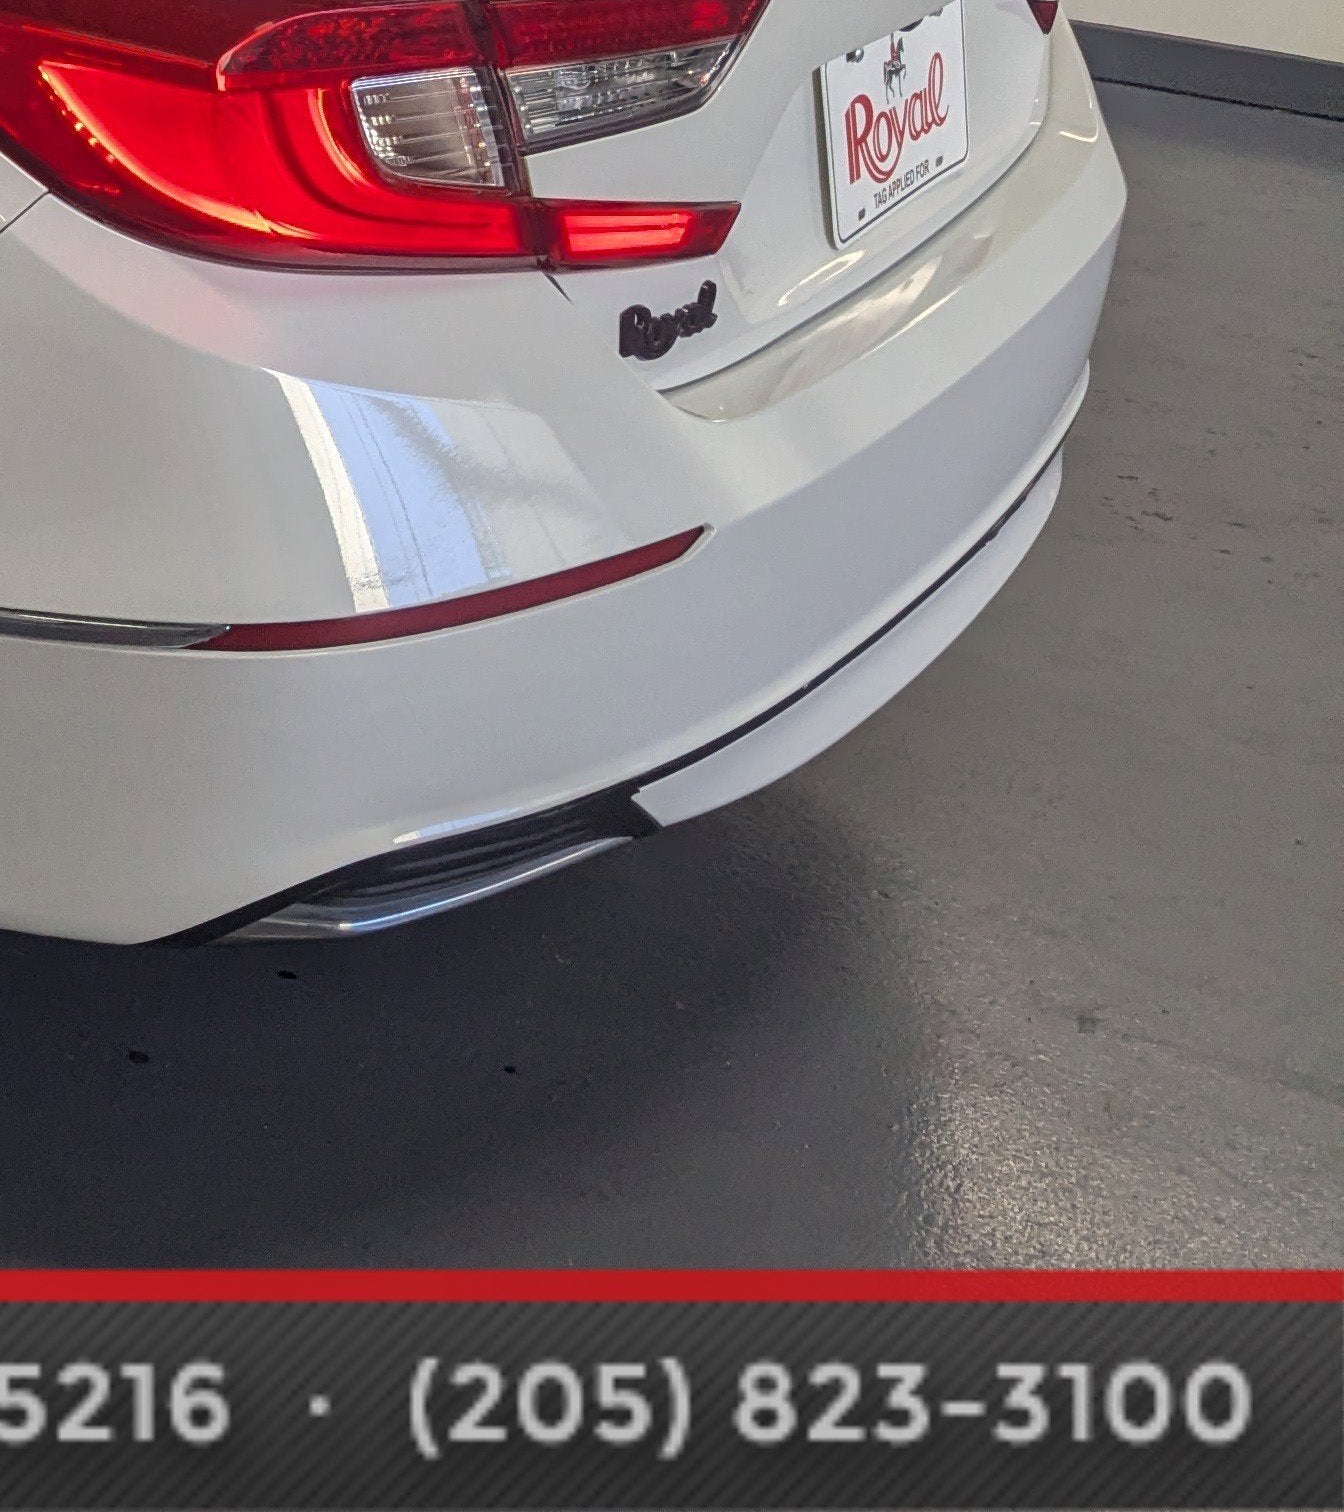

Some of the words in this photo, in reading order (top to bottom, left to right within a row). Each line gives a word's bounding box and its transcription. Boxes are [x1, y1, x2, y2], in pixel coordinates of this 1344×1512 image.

[845, 51, 949, 185] Royal
[873, 187, 888, 209] TAG
[888, 168, 915, 200] APPLIED
[915, 159, 929, 181] FOR
[619, 279, 718, 361] Royal
